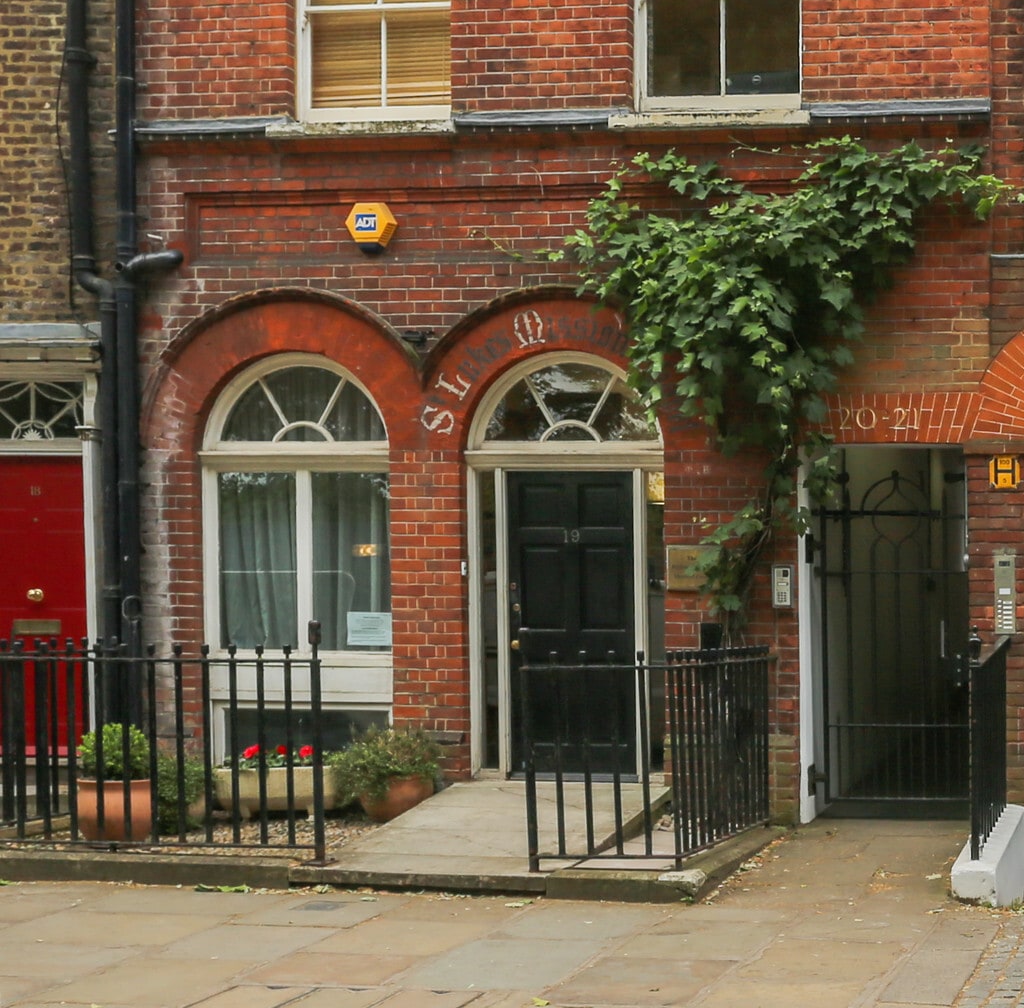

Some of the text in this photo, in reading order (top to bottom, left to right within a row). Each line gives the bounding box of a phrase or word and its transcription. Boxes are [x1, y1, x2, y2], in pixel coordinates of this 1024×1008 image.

[355, 216, 376, 228] ADT
[839, 407, 921, 430] 20-21
[563, 529, 580, 543] 19
